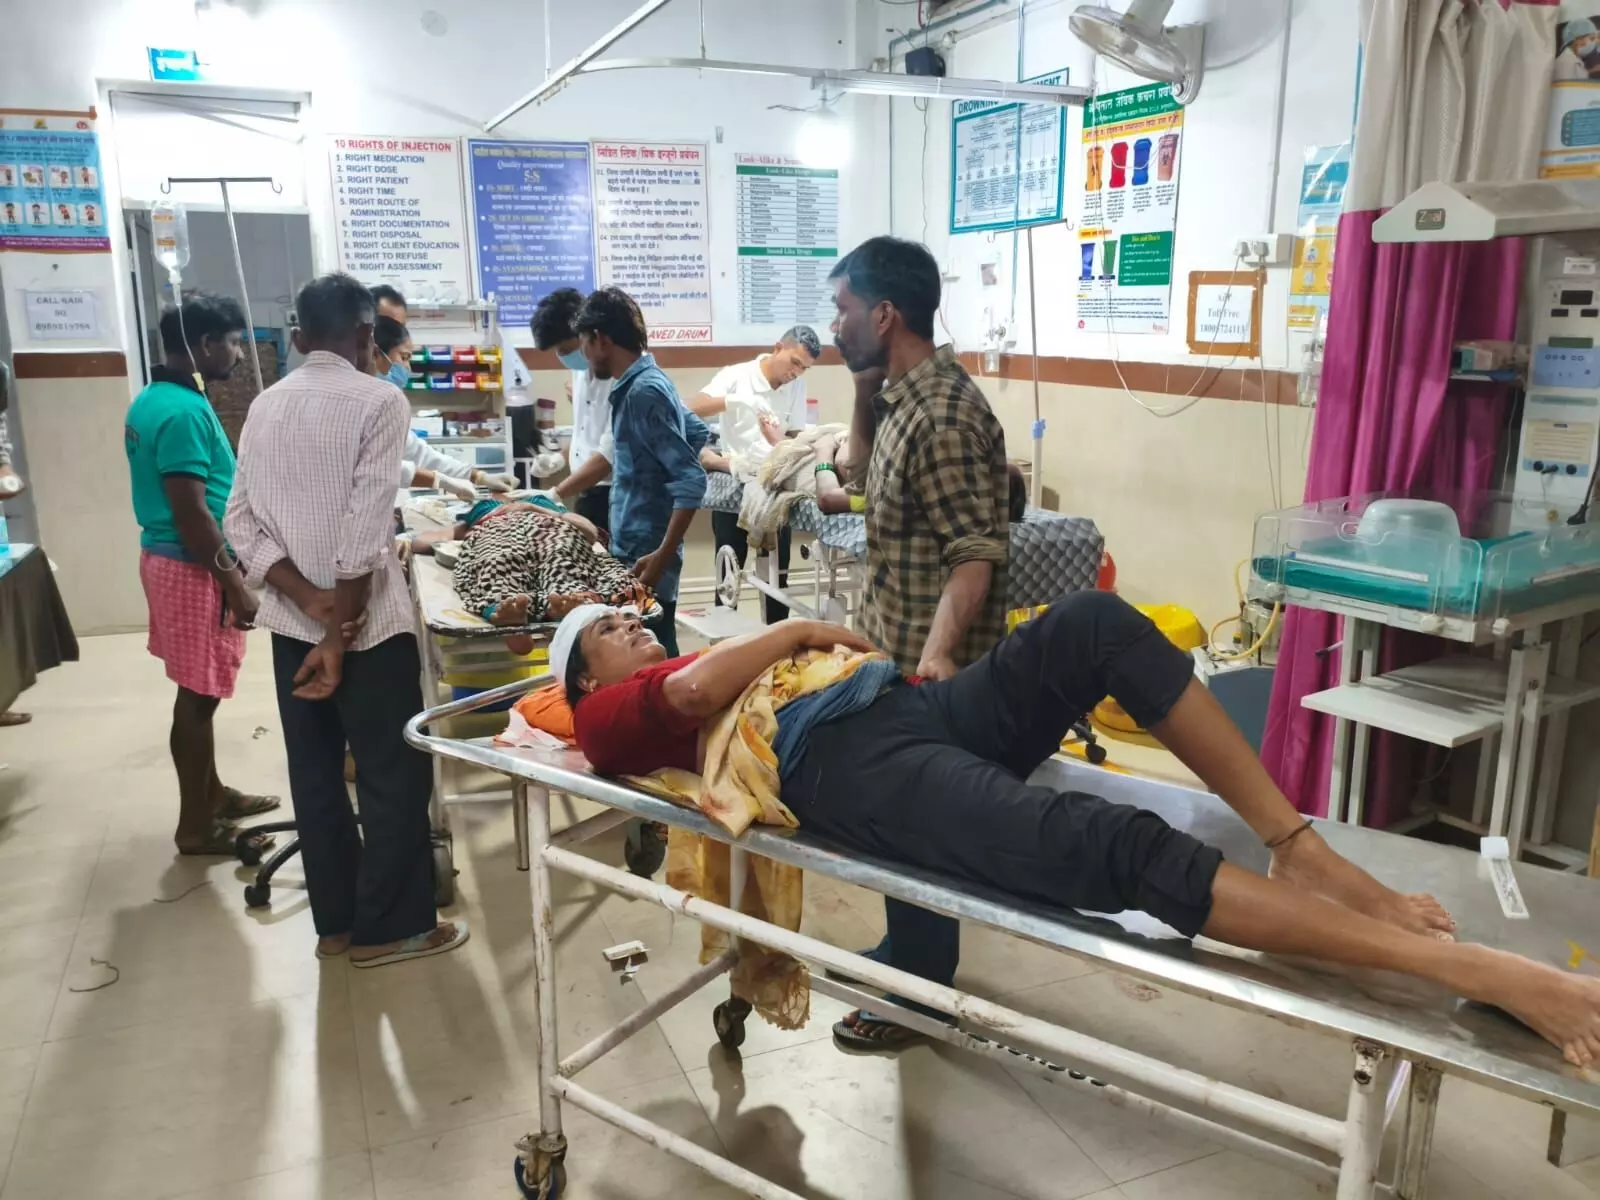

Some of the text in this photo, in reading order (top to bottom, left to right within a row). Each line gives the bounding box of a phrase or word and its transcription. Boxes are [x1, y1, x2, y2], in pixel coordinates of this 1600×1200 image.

[334, 139, 452, 151] 10 RIGHTS OF INJECTION
[345, 154, 371, 162] RIGHT
[373, 155, 425, 163] MEDICATION
[346, 165, 372, 173] RIGHT
[374, 166, 398, 174] DOSE
[347, 176, 373, 184] RIGHT
[375, 177, 409, 185] PATIENT
[348, 187, 373, 195] RIGHT
[349, 198, 375, 206] RIGHT
[350, 209, 421, 217] ADMINISTRATION
[351, 220, 377, 228] RIGHT
[379, 220, 450, 228] DOCUMENTATION
[352, 231, 377, 239] RIGHT
[380, 231, 422, 239] DISPOSAL
[354, 252, 380, 260] RIGHT
[382, 252, 394, 260] TO
[395, 252, 429, 260] REFUSE
[360, 263, 386, 271] RIGHT
[676, 329, 709, 340] DRUM
